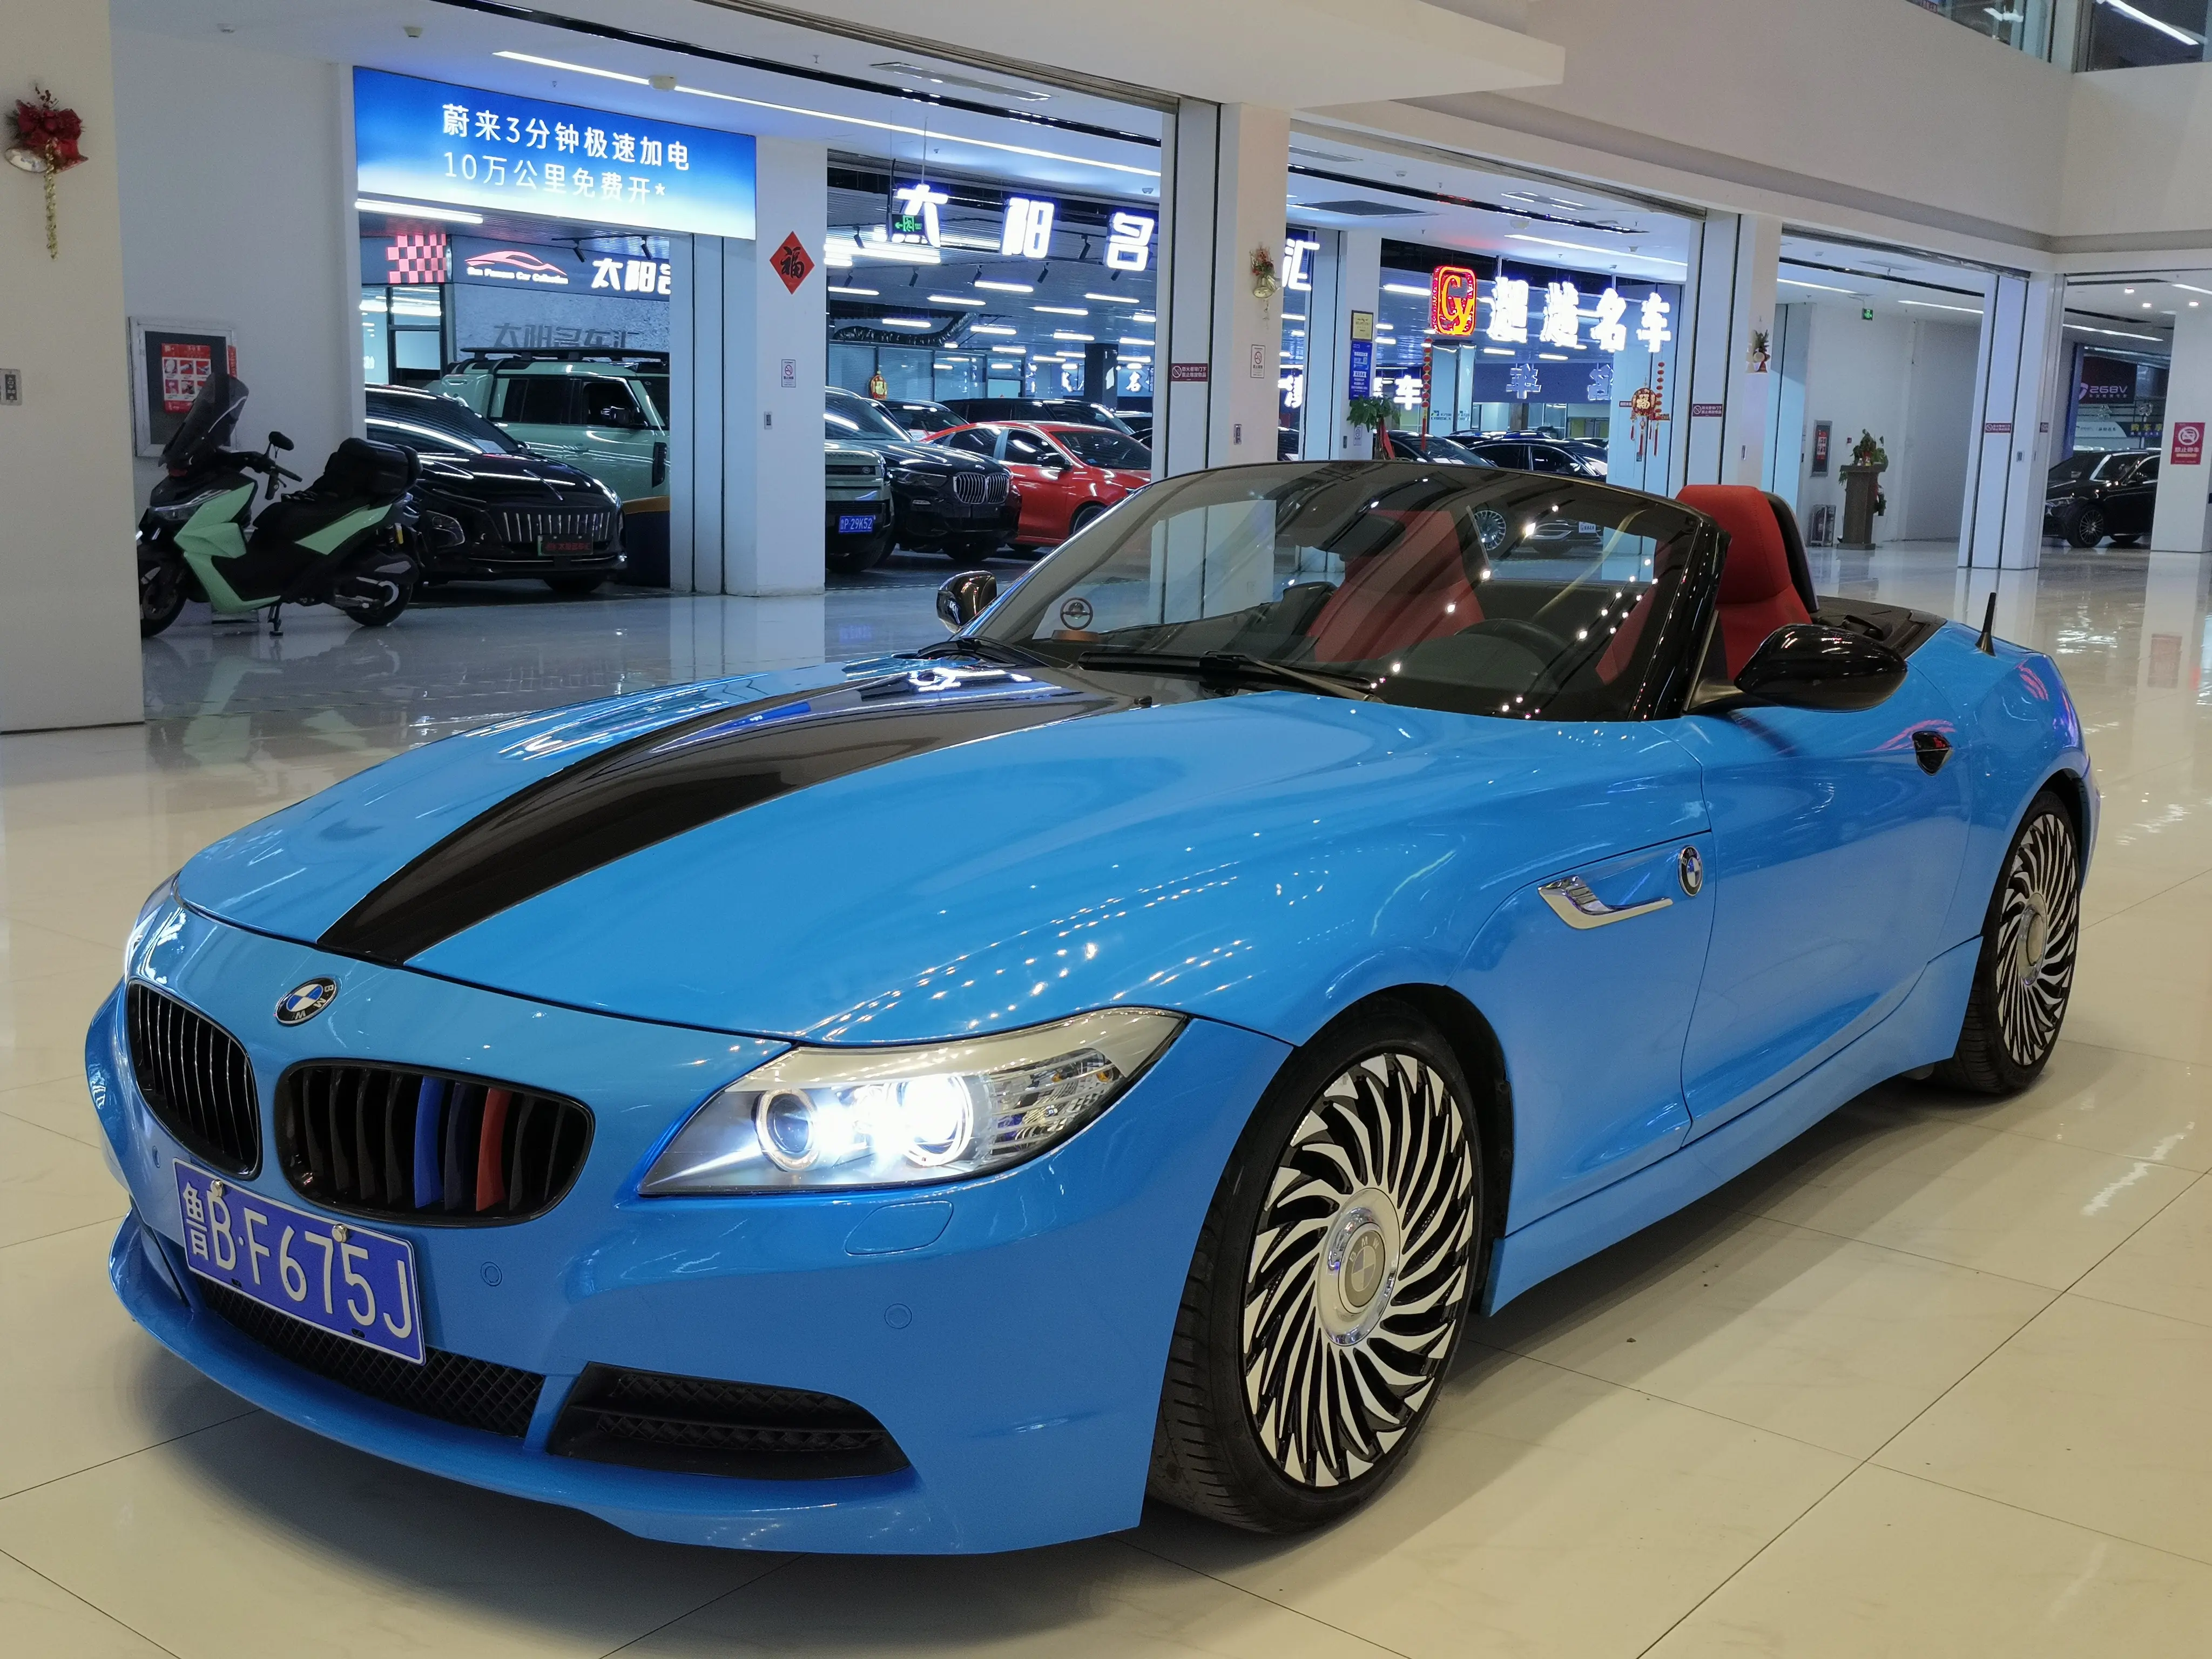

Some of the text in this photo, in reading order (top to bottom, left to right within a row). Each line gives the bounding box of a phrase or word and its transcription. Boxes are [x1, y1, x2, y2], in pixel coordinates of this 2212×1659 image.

[442, 103, 691, 172] 蔚来3分钟极速加电
[780, 246, 805, 279] 福
[2089, 385, 2128, 394] 268V
[294, 984, 334, 1020] BMW
